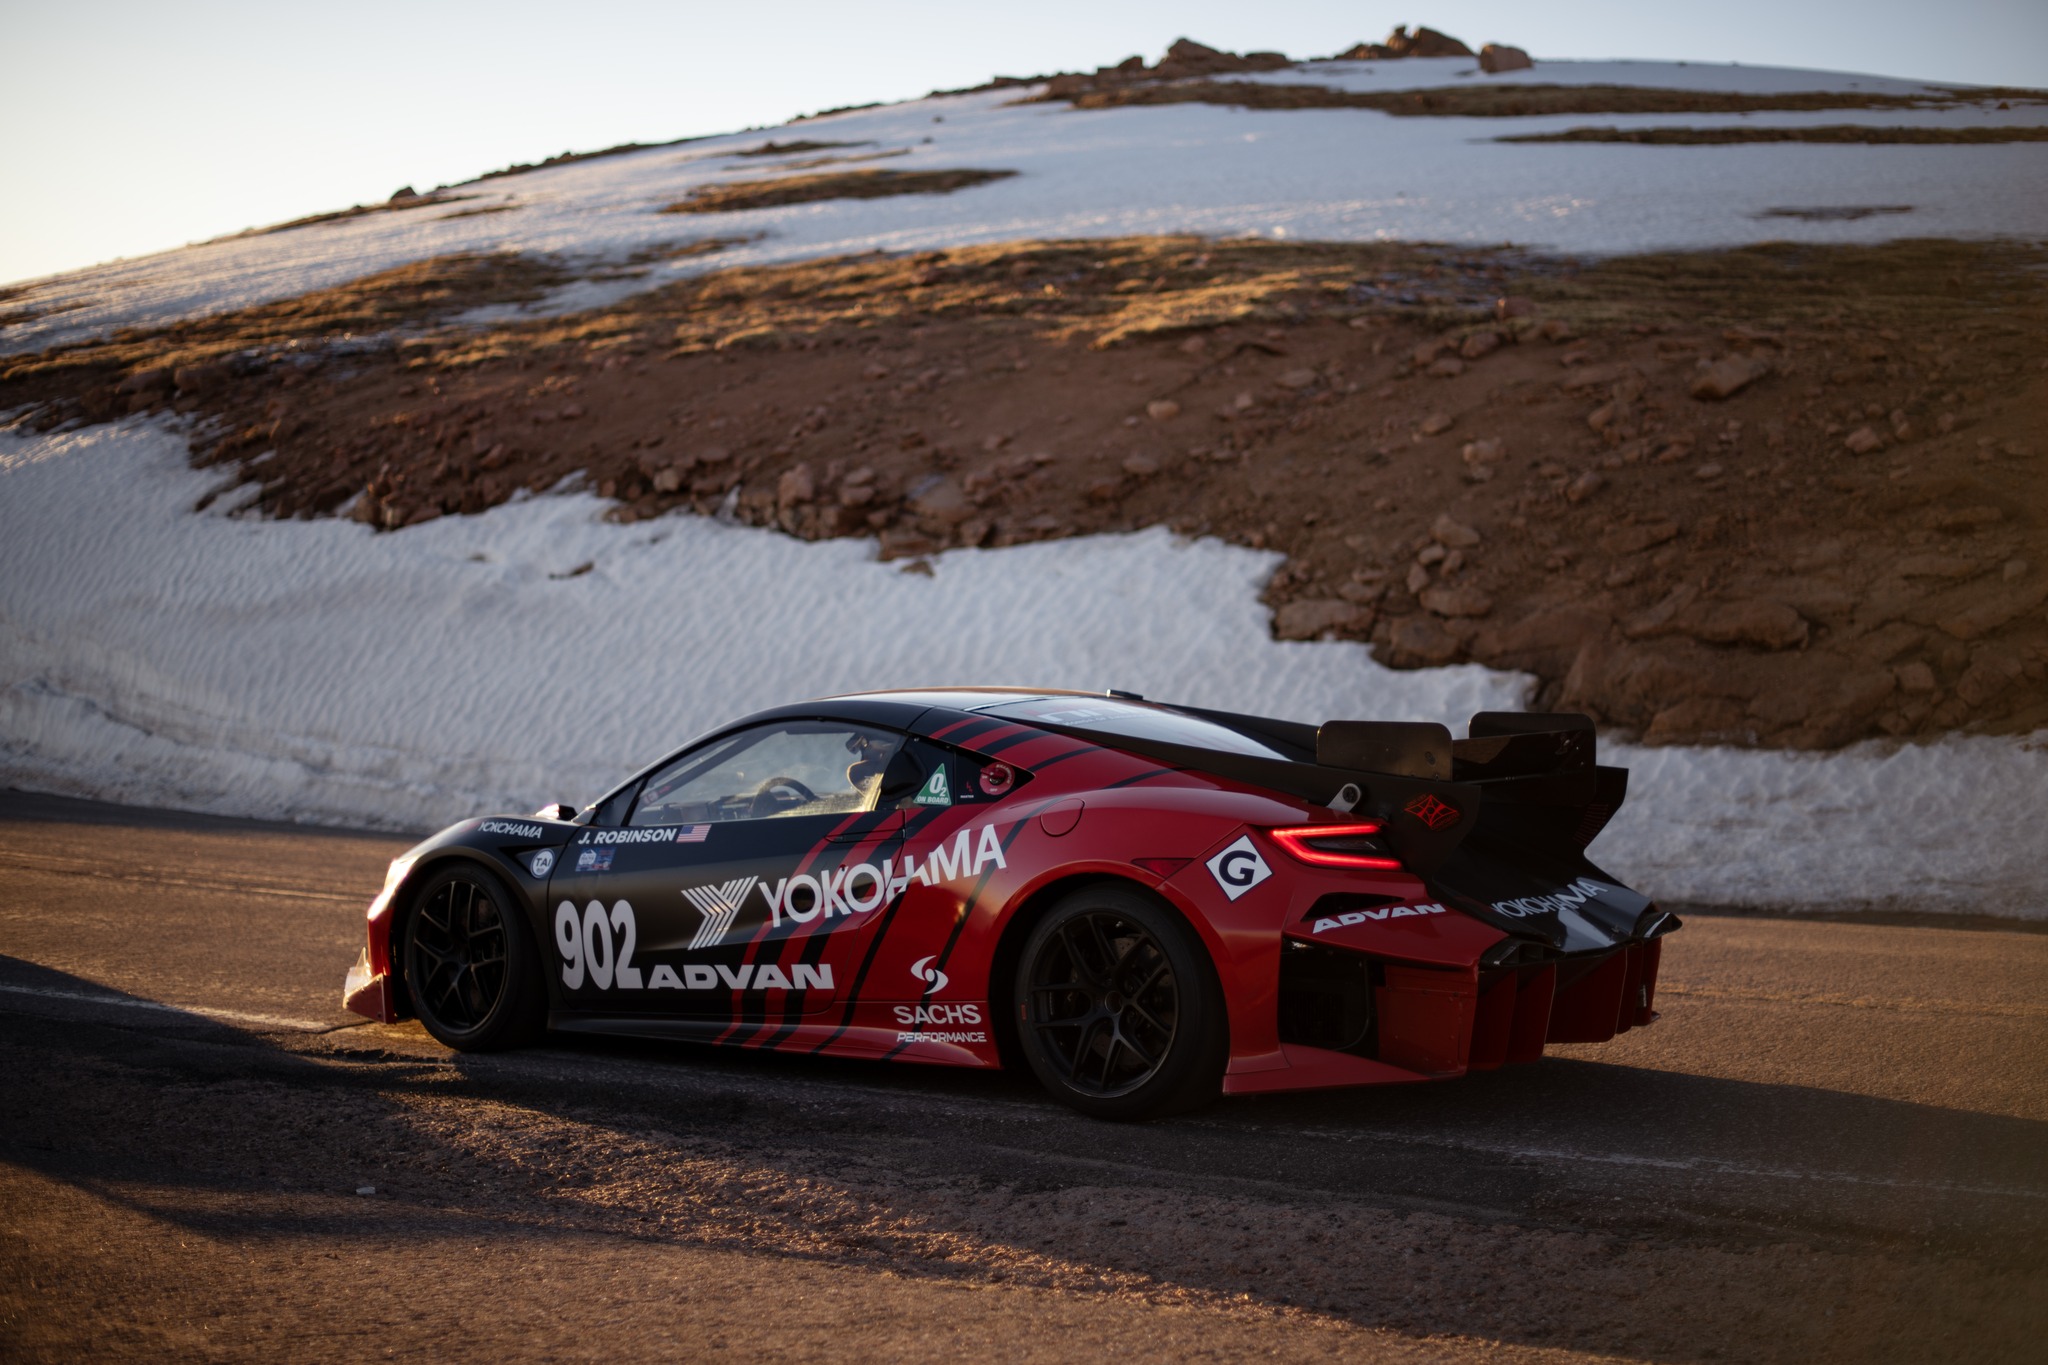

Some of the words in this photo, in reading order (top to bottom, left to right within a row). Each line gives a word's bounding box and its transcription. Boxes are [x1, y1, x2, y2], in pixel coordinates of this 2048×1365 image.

[478, 821, 543, 839] YOKOHAMA
[578, 832, 591, 845] J.
[594, 828, 677, 844] ROBINSON
[759, 823, 1007, 928] YOKOHAMA
[1219, 850, 1257, 887] G
[1491, 878, 1607, 918] YOKOHAMA
[1312, 903, 1446, 934] ADVAN
[555, 899, 643, 990] 902
[647, 963, 834, 990] ADVAN
[893, 1004, 982, 1025] SACHS
[897, 1032, 987, 1043] PERFORMANCE
